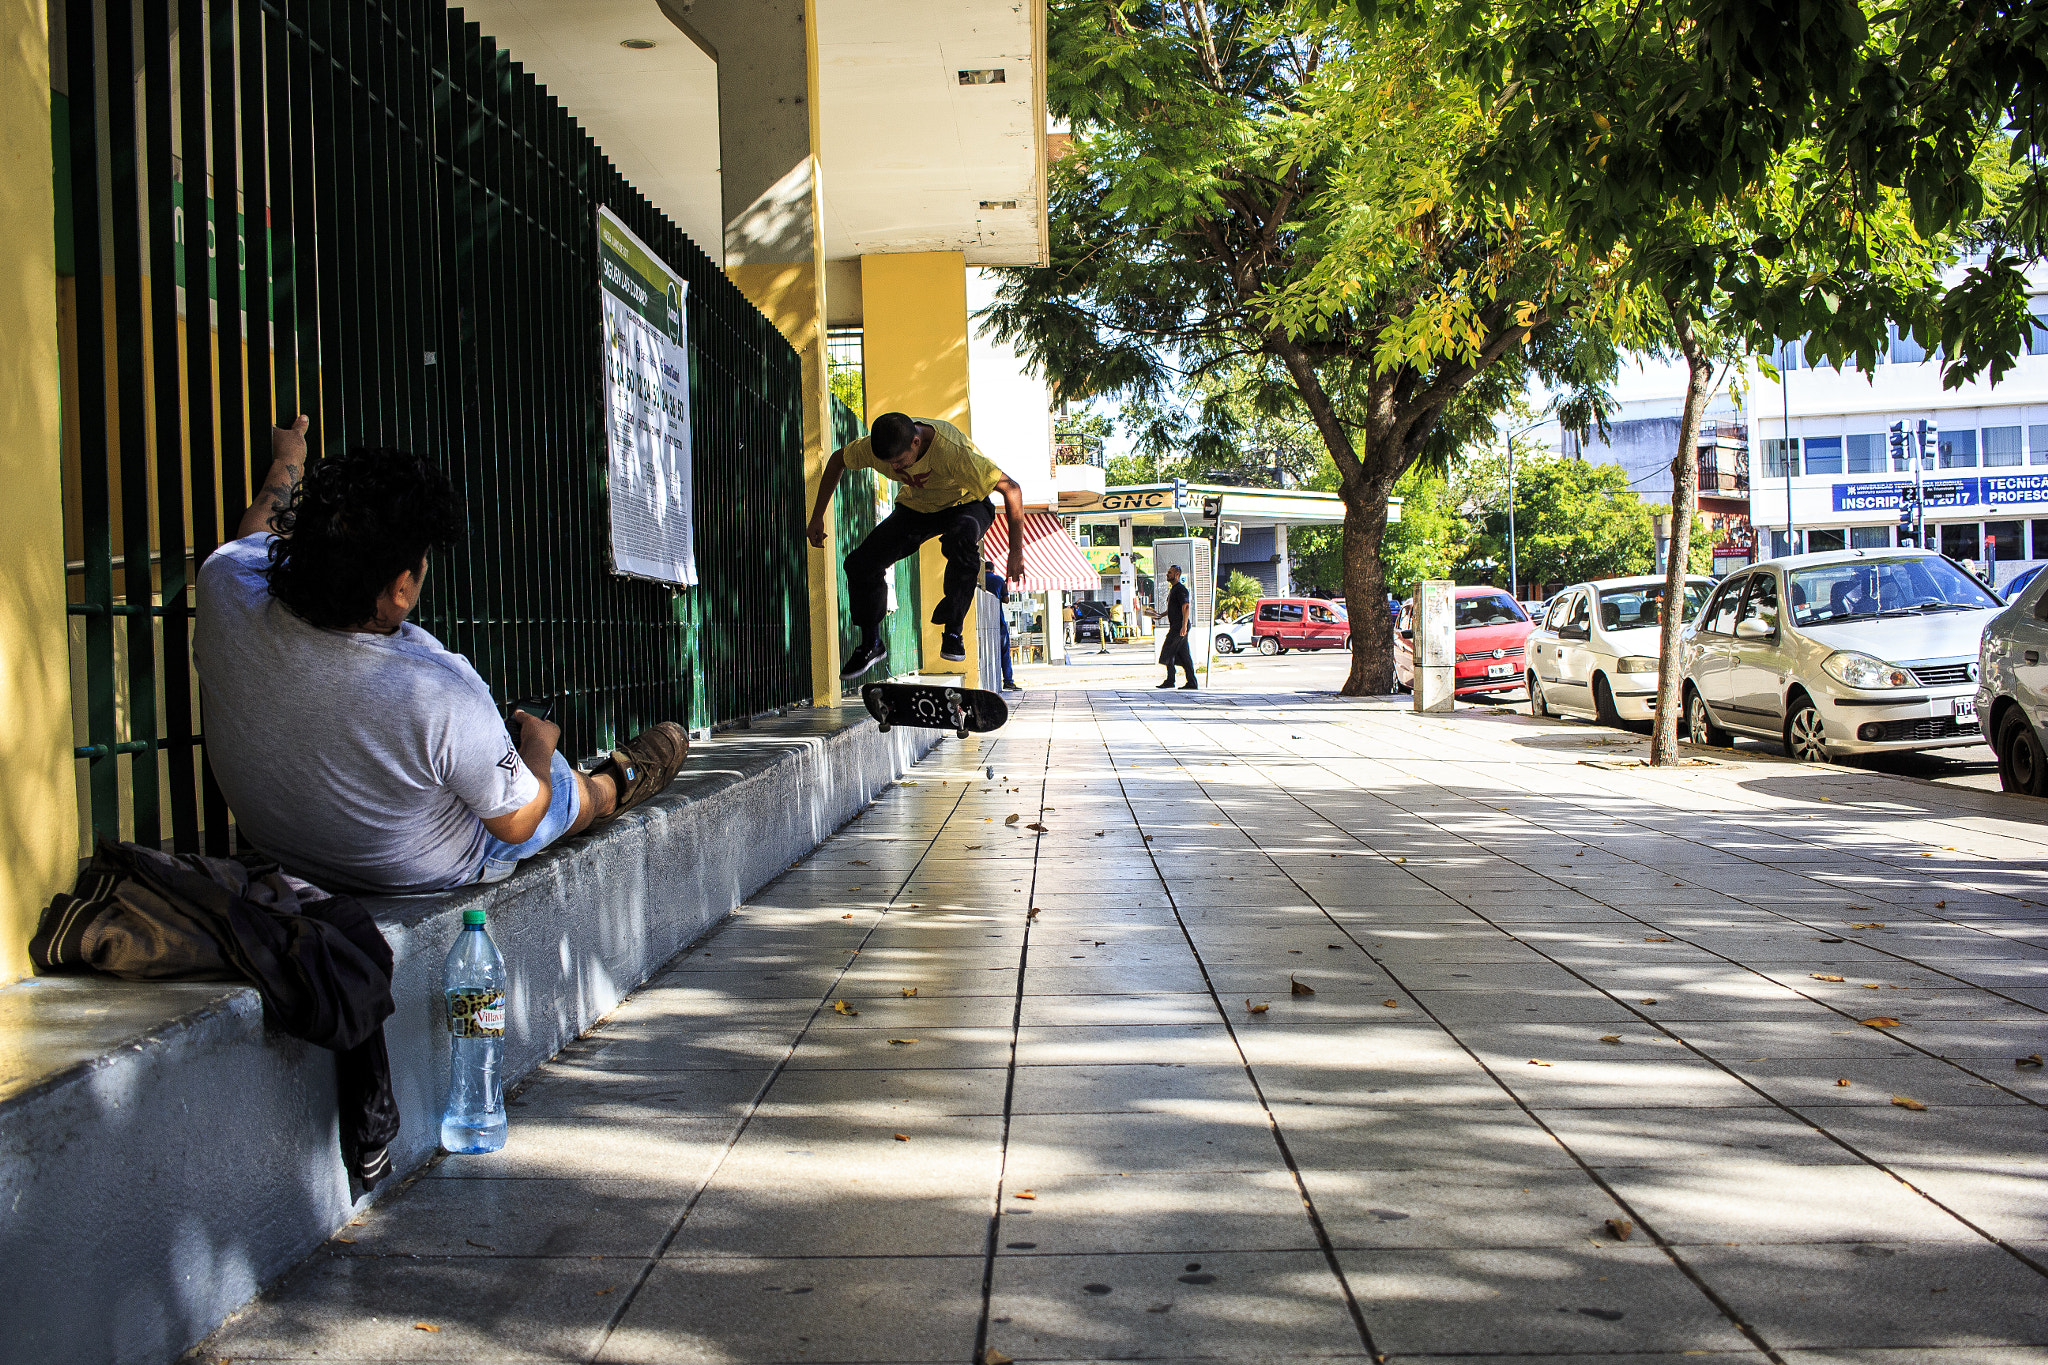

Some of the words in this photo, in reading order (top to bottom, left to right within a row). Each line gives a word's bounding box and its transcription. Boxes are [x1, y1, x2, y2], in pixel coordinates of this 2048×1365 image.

[1988, 477, 2048, 490] TECNICA
[1102, 493, 1163, 509] GNC
[1989, 490, 2048, 502] PROFESO
[1842, 496, 1934, 510] INSCRIPN
